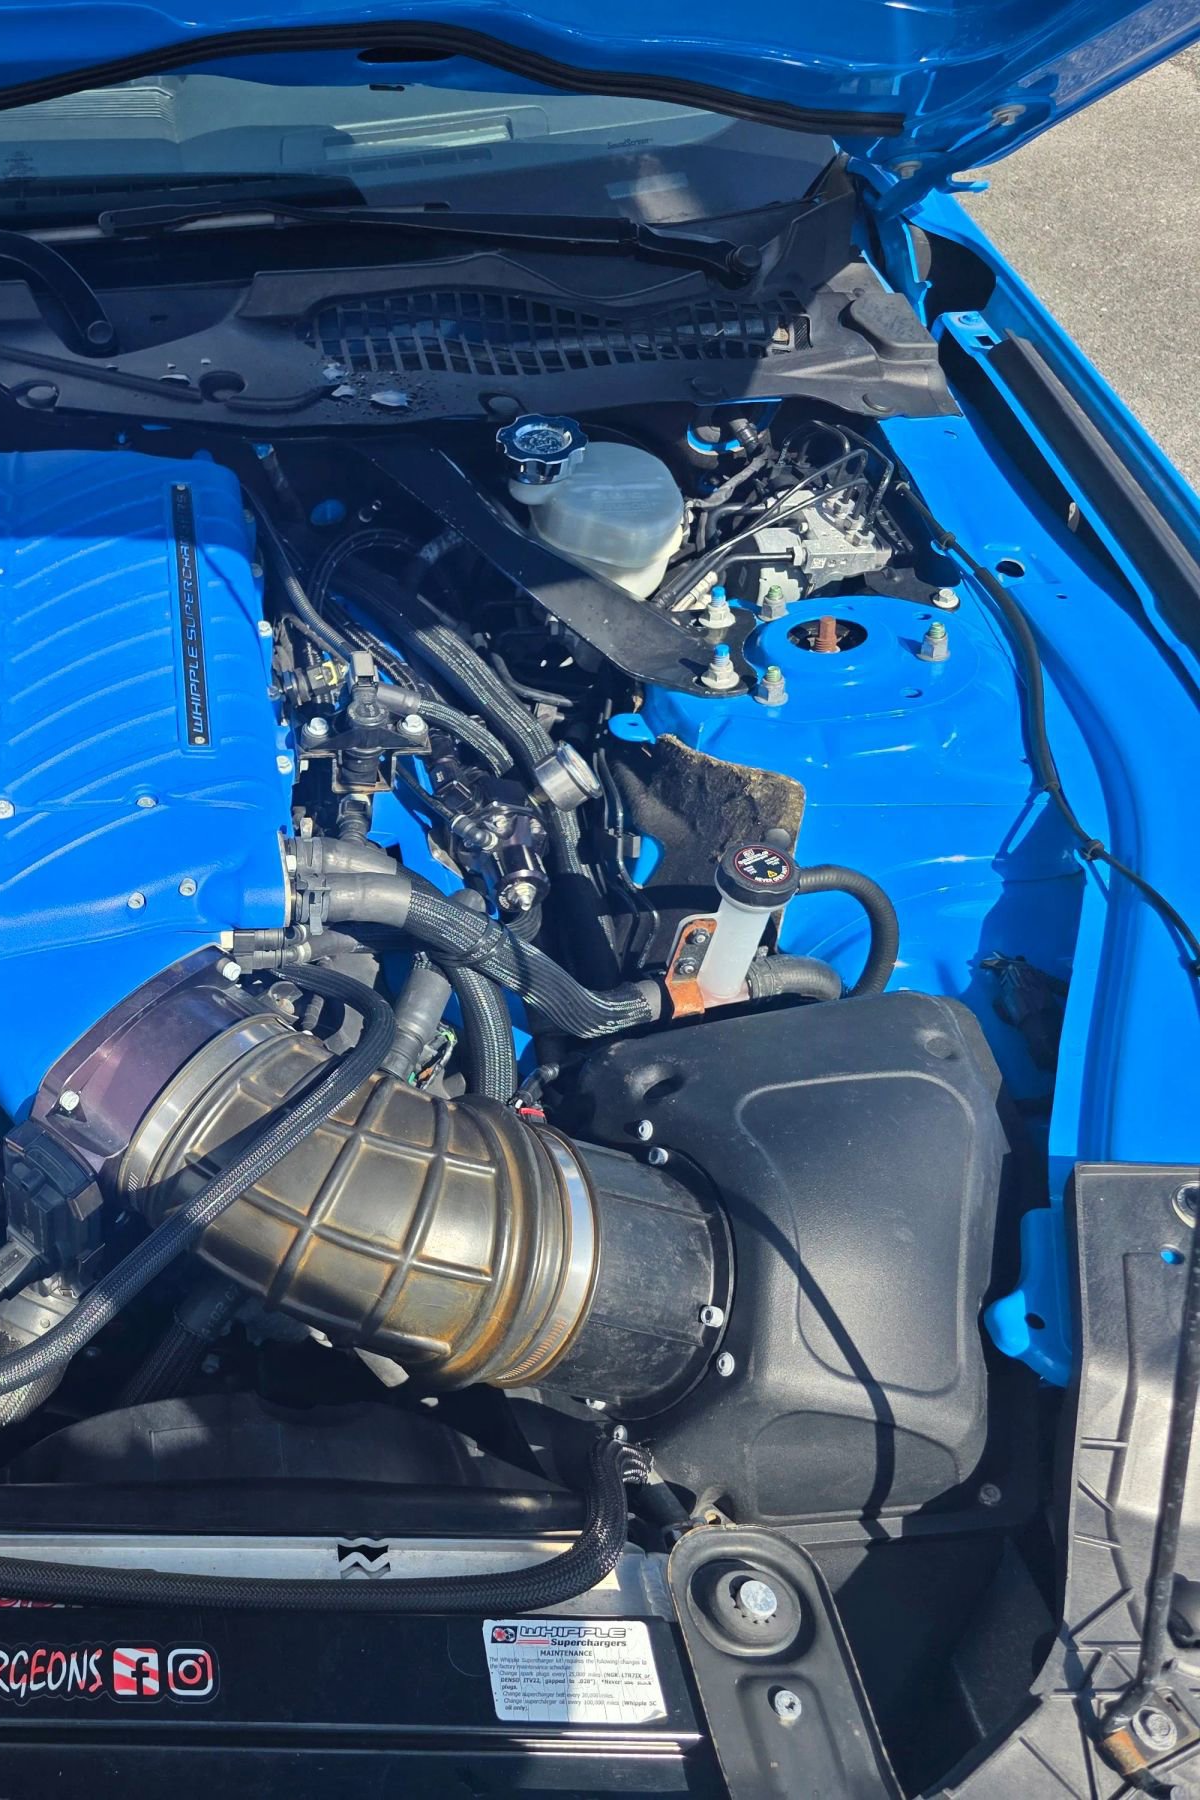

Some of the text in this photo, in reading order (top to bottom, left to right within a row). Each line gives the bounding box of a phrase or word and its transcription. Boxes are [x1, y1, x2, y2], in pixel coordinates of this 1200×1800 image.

[186, 647, 204, 734] WHIPPLE
[519, 1625, 627, 1638] WHIPPLE
[550, 1638, 627, 1647] Superchargers
